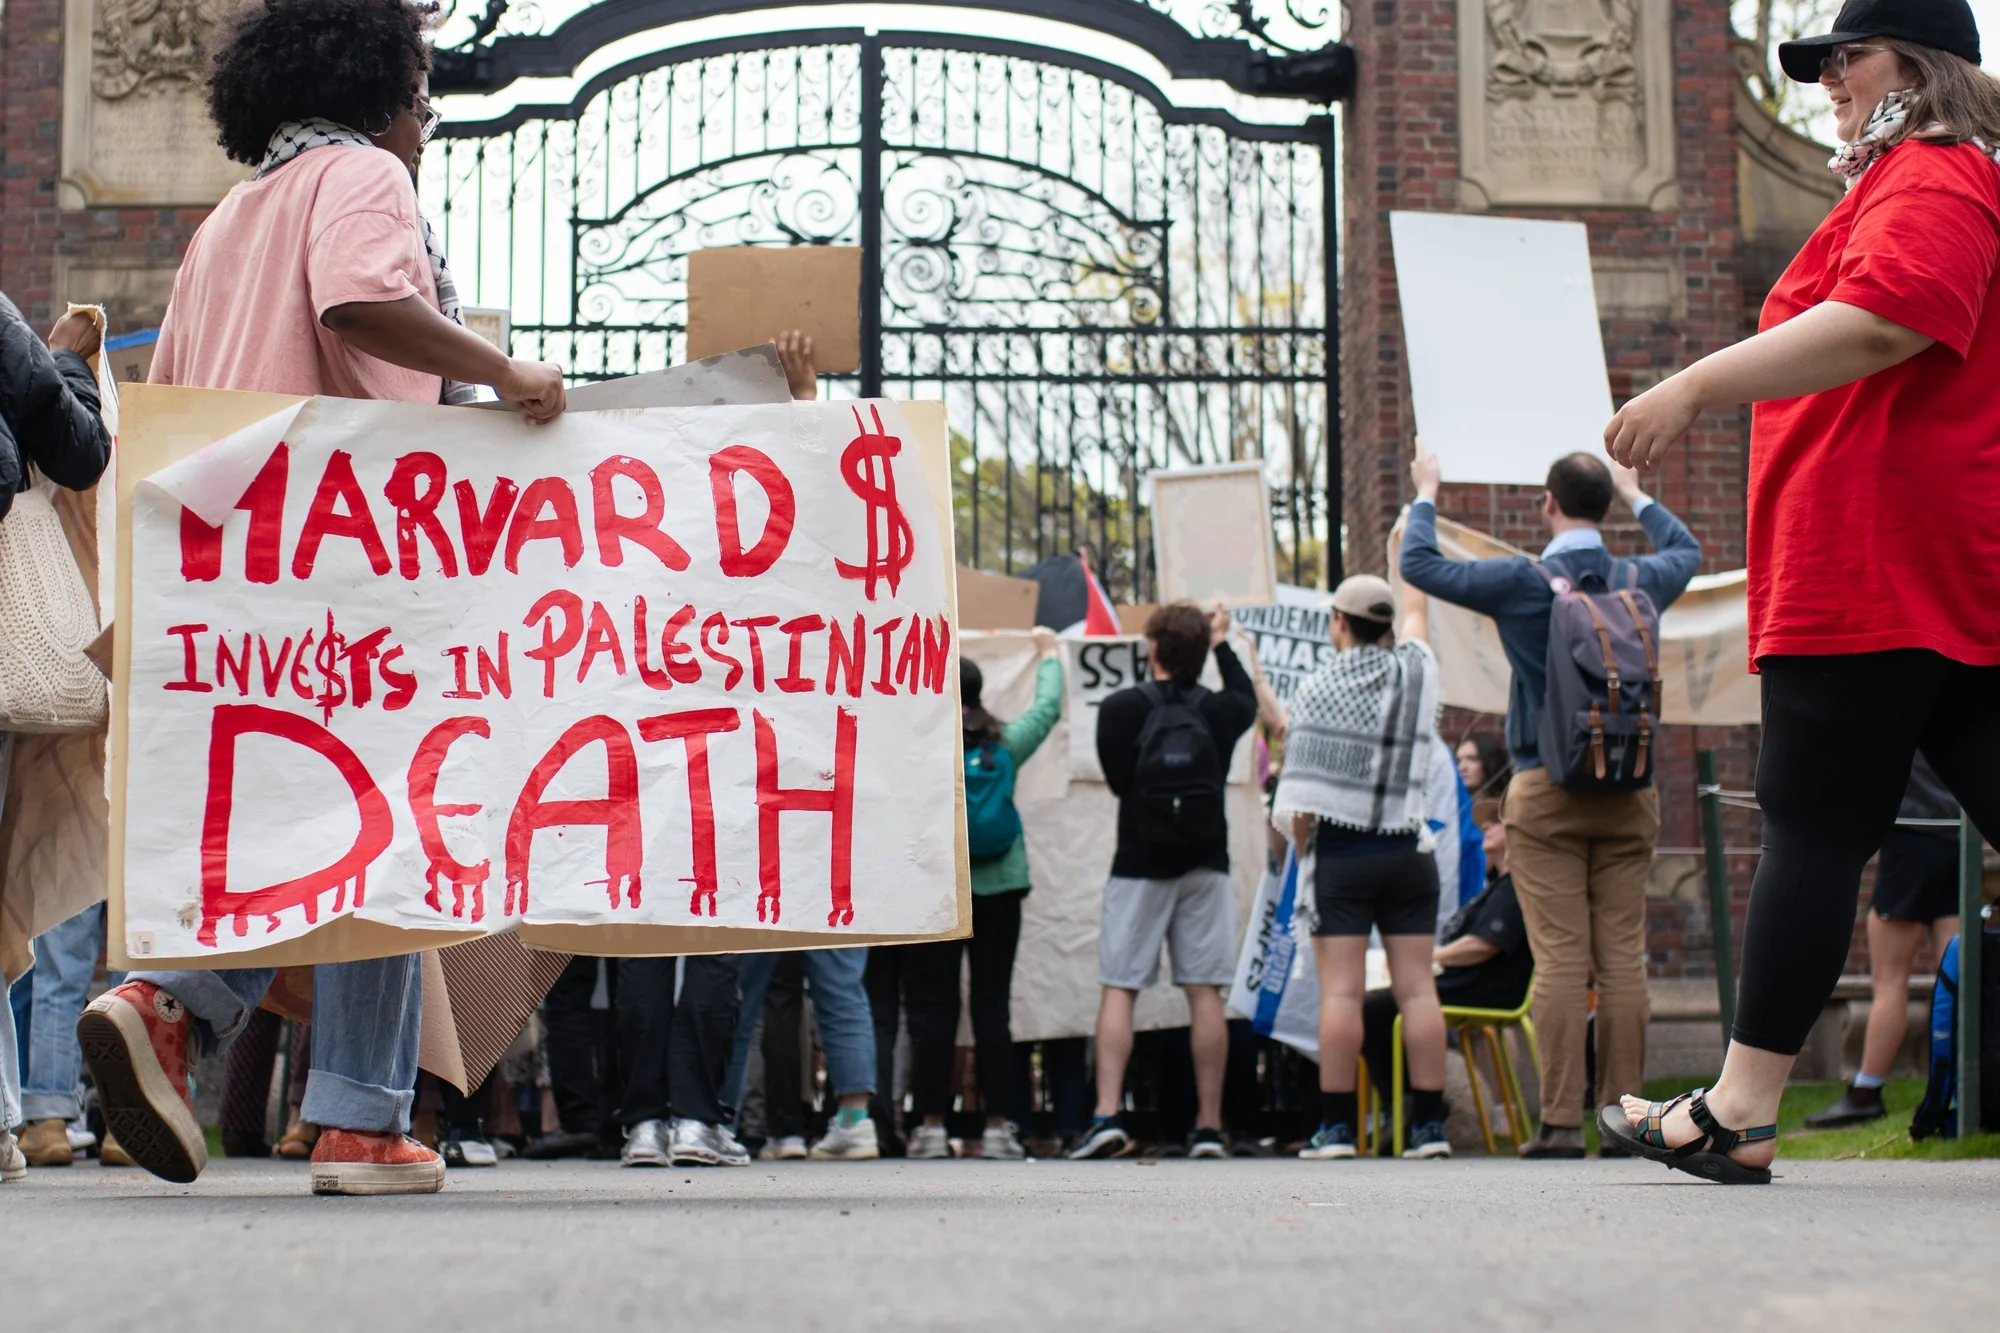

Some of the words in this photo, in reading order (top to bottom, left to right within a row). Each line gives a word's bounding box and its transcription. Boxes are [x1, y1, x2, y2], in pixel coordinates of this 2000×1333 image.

[180, 441, 796, 584] HARVARD
[444, 631, 512, 700] IN
[524, 589, 950, 698] PALESTINIAN
[197, 704, 857, 946] DEATH
